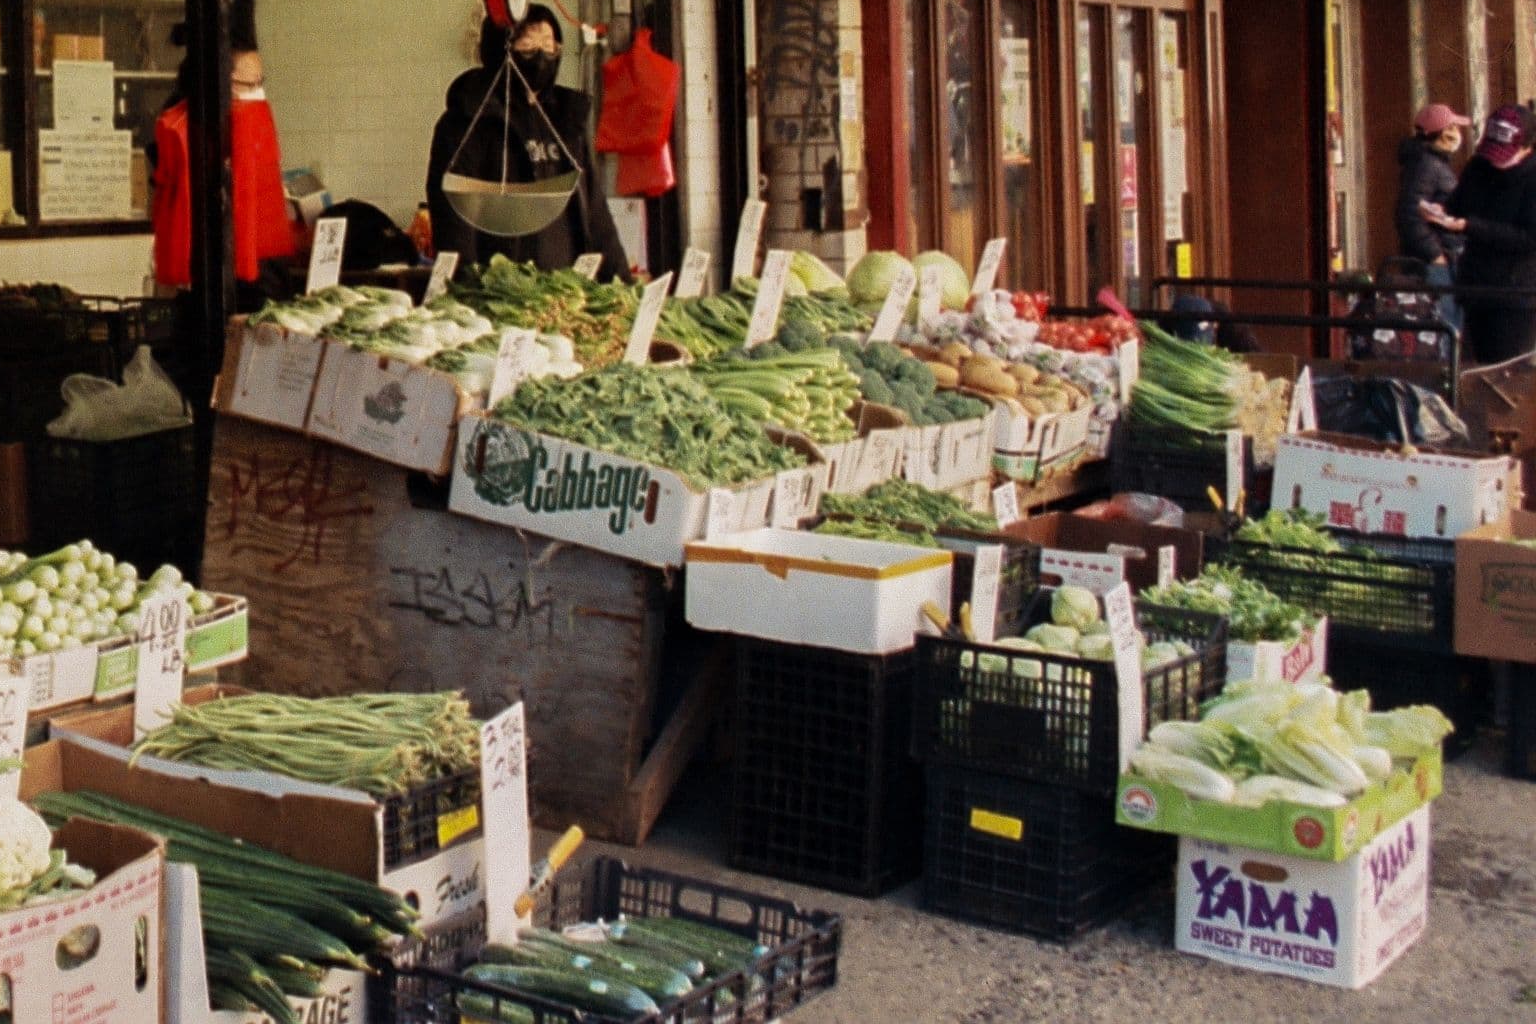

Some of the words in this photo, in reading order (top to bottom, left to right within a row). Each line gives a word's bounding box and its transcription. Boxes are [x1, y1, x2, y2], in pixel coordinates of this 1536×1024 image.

[523, 442, 651, 535] Cabbage
[1190, 859, 1339, 948] YAMA
[1190, 921, 1245, 950] SWEET
[1248, 935, 1337, 969] POTATOES
